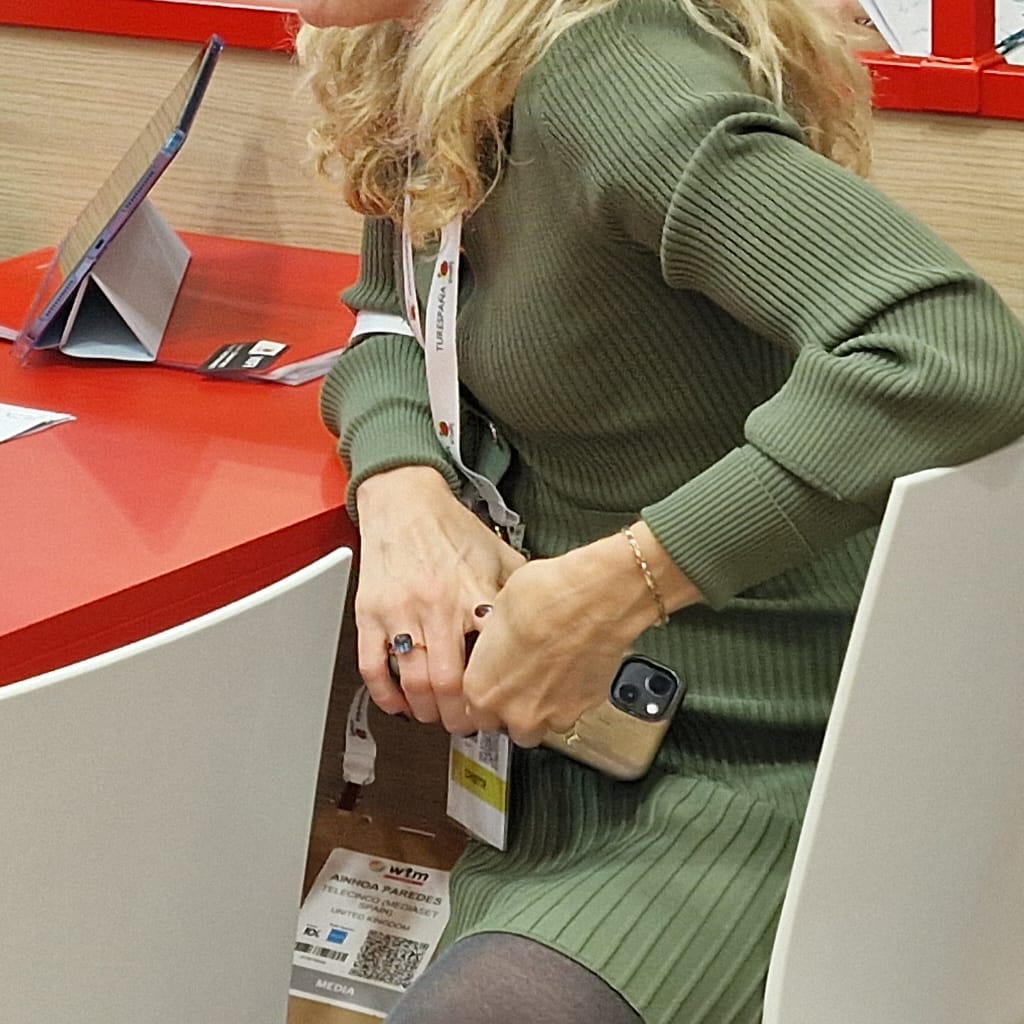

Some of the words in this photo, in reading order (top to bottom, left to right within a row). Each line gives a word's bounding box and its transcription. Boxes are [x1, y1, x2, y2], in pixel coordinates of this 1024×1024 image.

[388, 864, 429, 881] wtm
[382, 885, 442, 905] PAREDES
[315, 979, 355, 996] MEDIA
